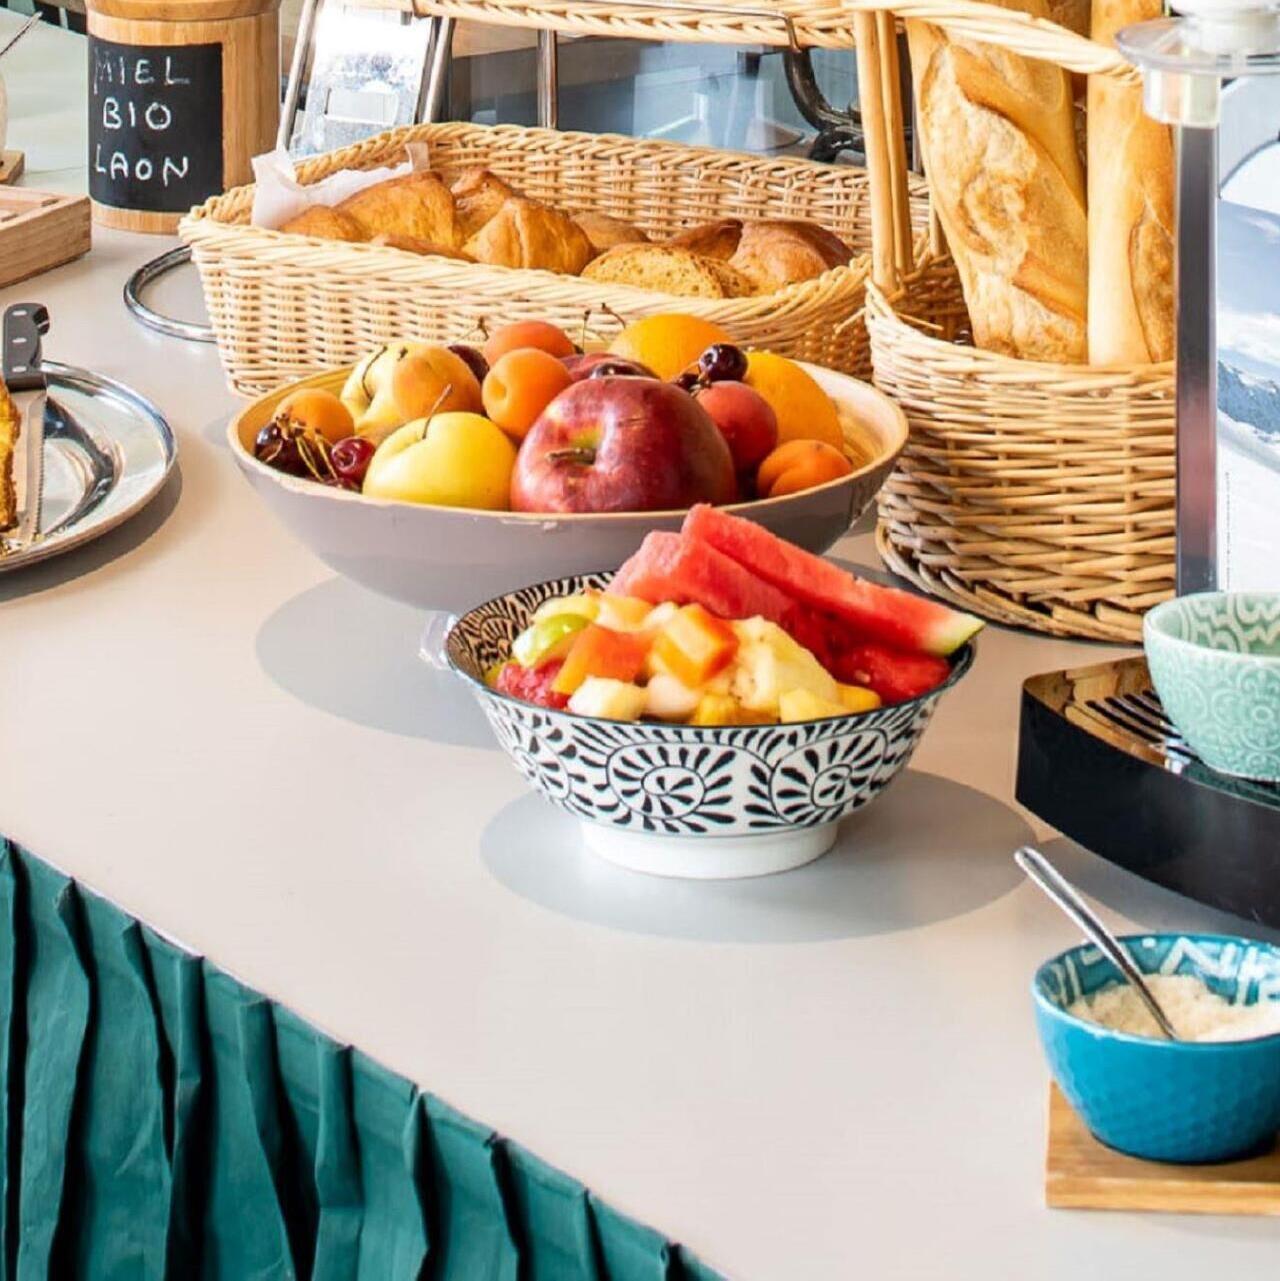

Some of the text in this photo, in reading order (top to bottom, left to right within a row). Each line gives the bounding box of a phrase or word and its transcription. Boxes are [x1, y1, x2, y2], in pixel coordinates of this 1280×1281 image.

[93, 46, 190, 95] MIEL
[103, 97, 171, 131] BIO
[96, 143, 189, 187] LAON
